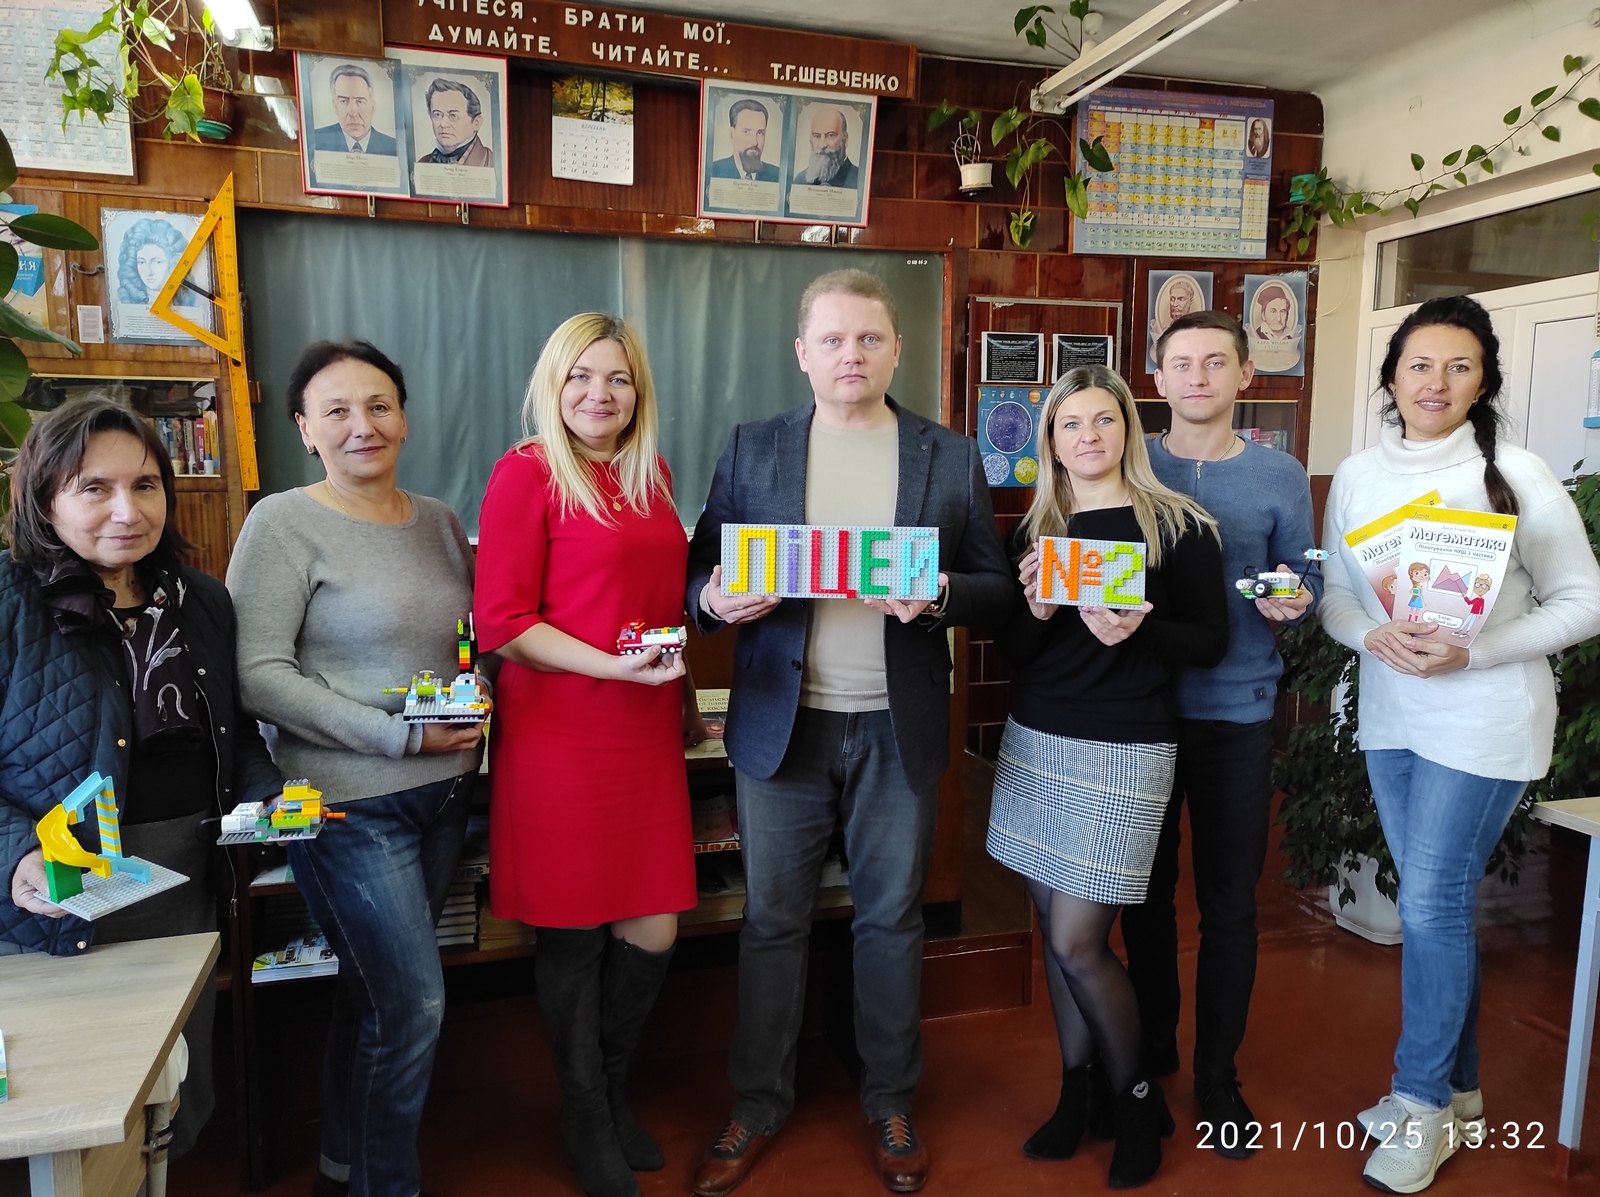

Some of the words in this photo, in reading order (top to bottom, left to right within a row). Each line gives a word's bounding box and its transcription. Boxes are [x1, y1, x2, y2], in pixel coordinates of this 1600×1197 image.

[564, 7, 645, 34] БРАТИ
[769, 62, 899, 92] Т.Г.ШЕВЧЕНКО
[1409, 526, 1507, 552] Математика
[1418, 544, 1453, 553] Пілотування
